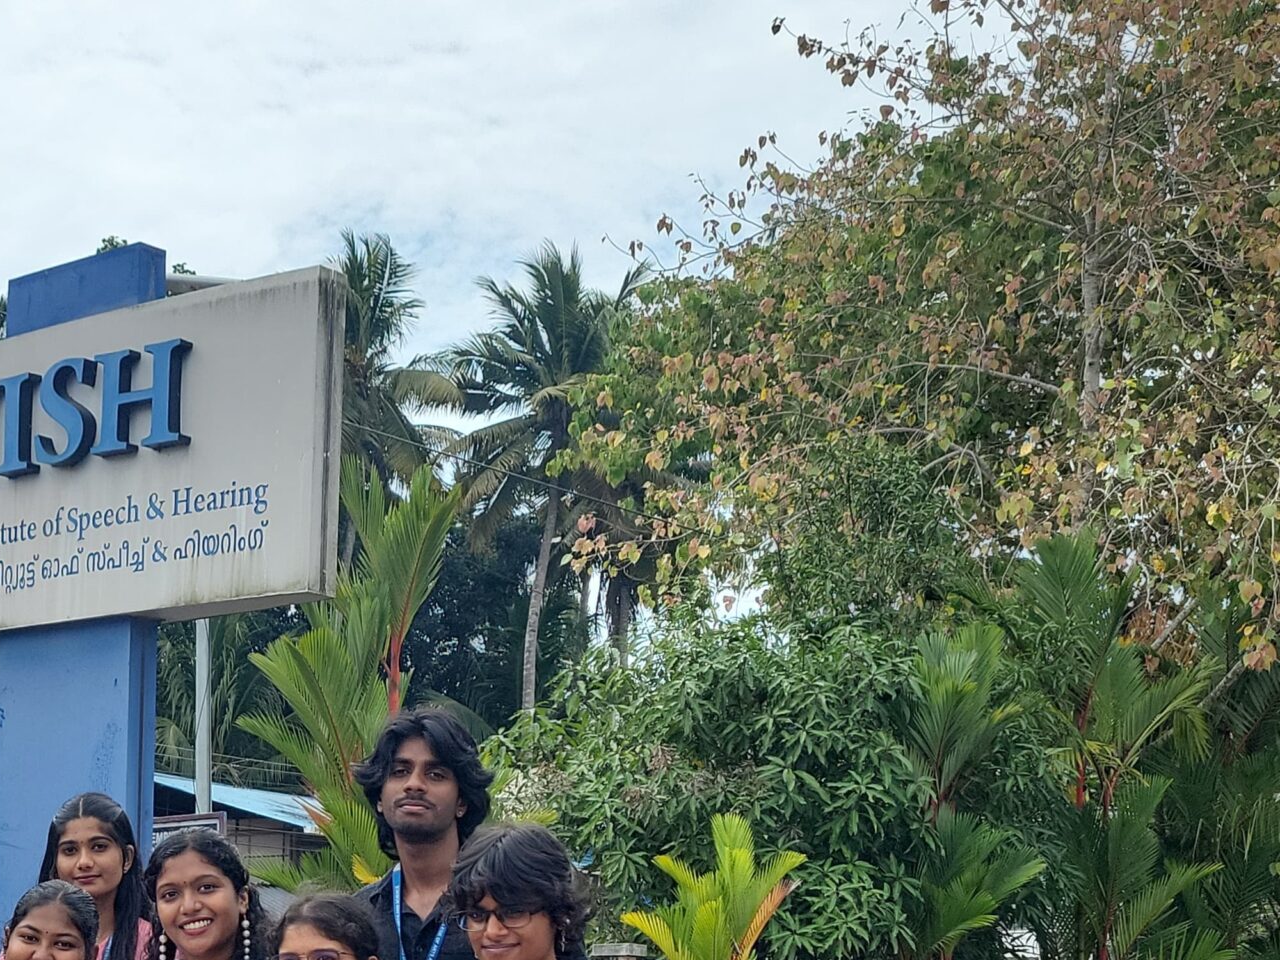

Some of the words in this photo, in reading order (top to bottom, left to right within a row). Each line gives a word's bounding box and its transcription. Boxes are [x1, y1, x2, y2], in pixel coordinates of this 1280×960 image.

[42, 506, 65, 537] of
[66, 495, 140, 541] Speech
[146, 492, 165, 520] &
[172, 481, 269, 515] Hearing
[41, 547, 84, 580] ഓഫ്
[152, 539, 168, 563] &
